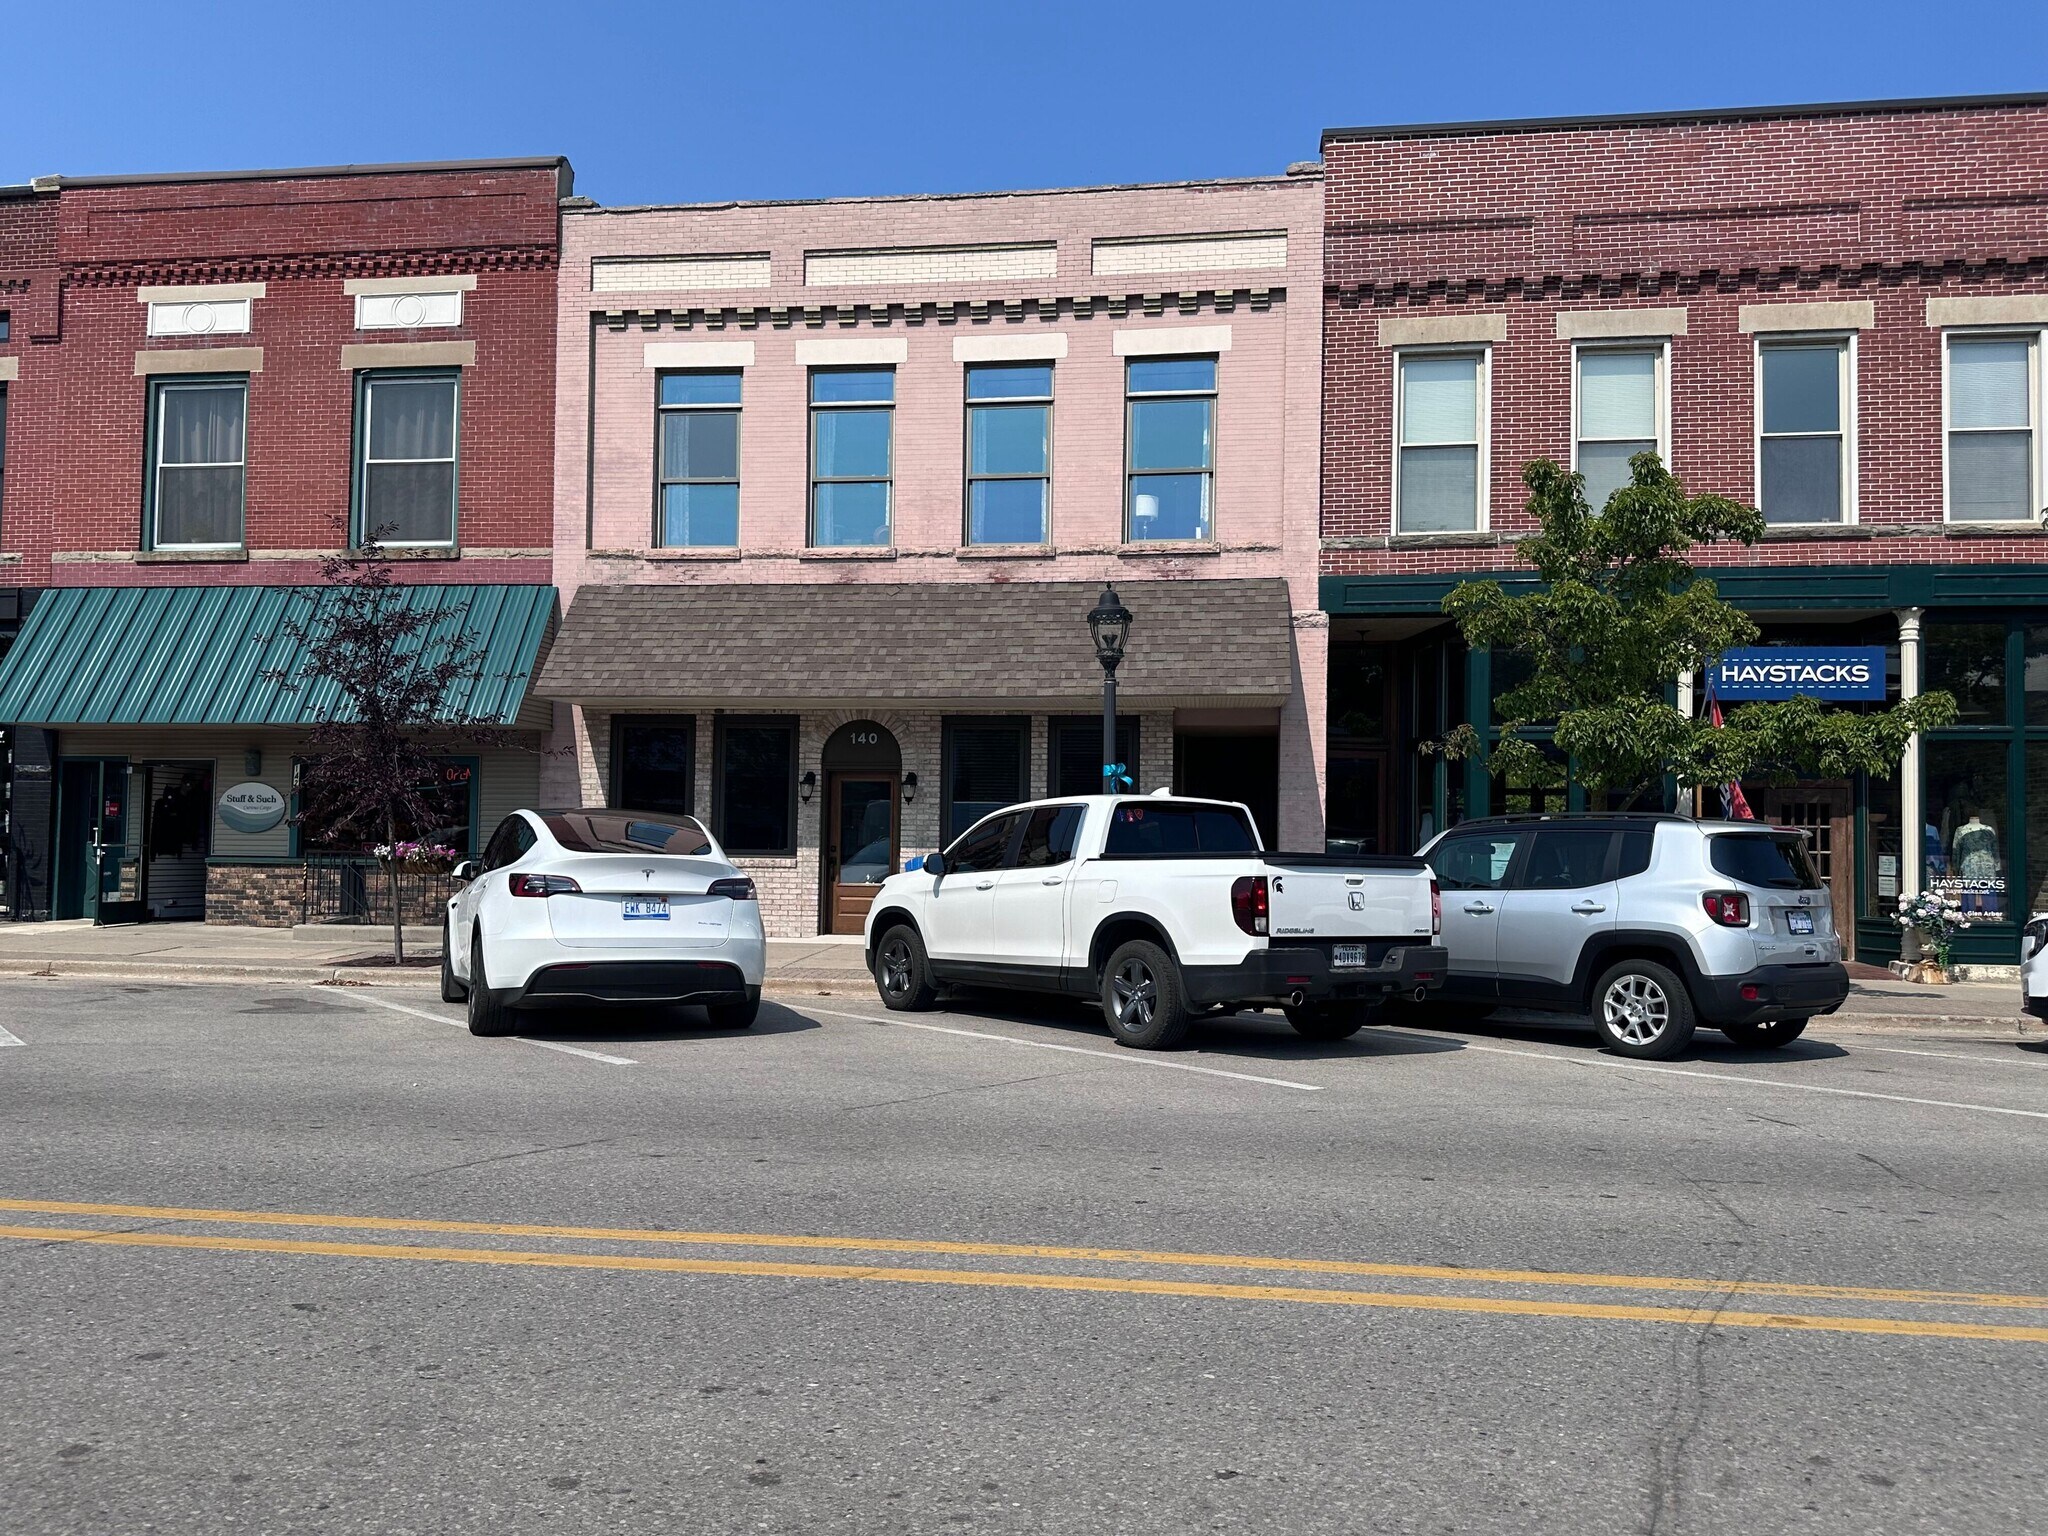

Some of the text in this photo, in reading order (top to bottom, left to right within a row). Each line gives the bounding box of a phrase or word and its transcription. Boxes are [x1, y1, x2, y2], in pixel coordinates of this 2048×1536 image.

[1721, 665, 1870, 683] HAYSTACKS
[850, 732, 878, 745] 140
[226, 795, 246, 803] Stuff
[256, 795, 277, 803] Such
[1930, 879, 2005, 889] HAYSTACKS
[646, 902, 667, 914] 8474
